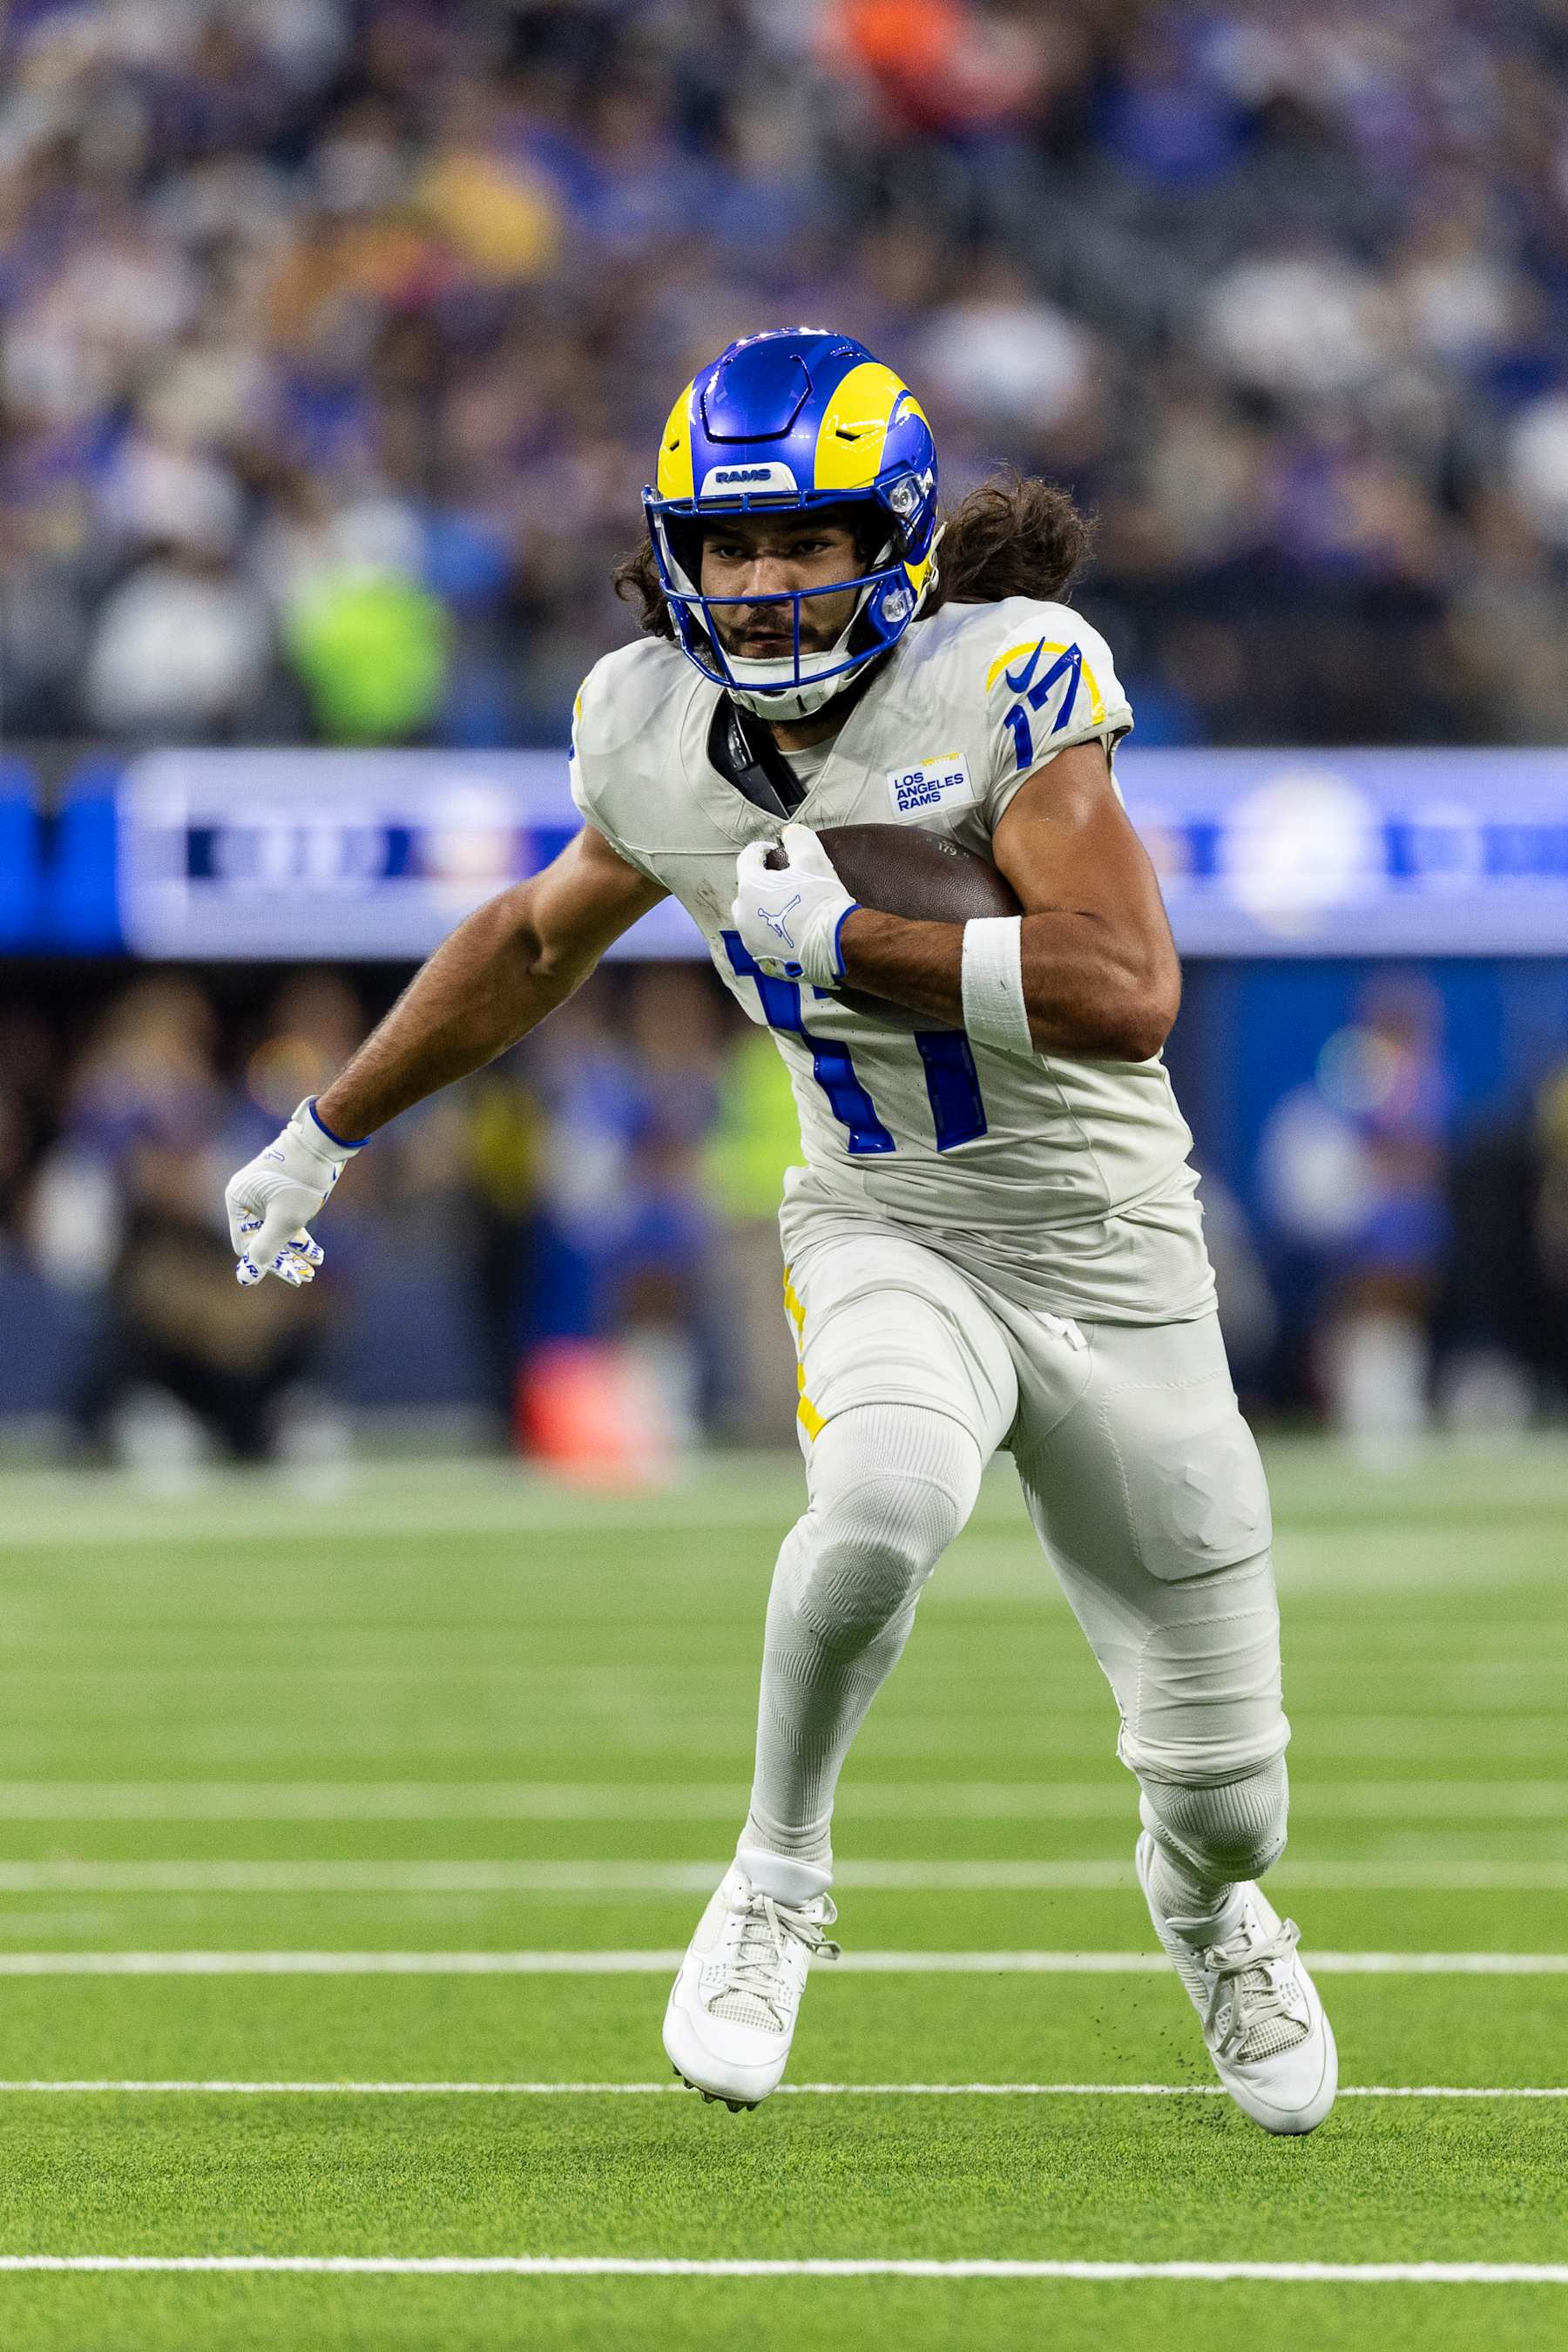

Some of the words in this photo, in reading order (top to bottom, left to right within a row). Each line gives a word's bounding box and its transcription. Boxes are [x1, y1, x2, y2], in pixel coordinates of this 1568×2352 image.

[715, 469, 772, 483] RAMS
[1004, 642, 1083, 770] 17
[894, 772, 924, 789] LOS
[896, 773, 964, 801] ANGELES
[898, 791, 942, 811] RAMS
